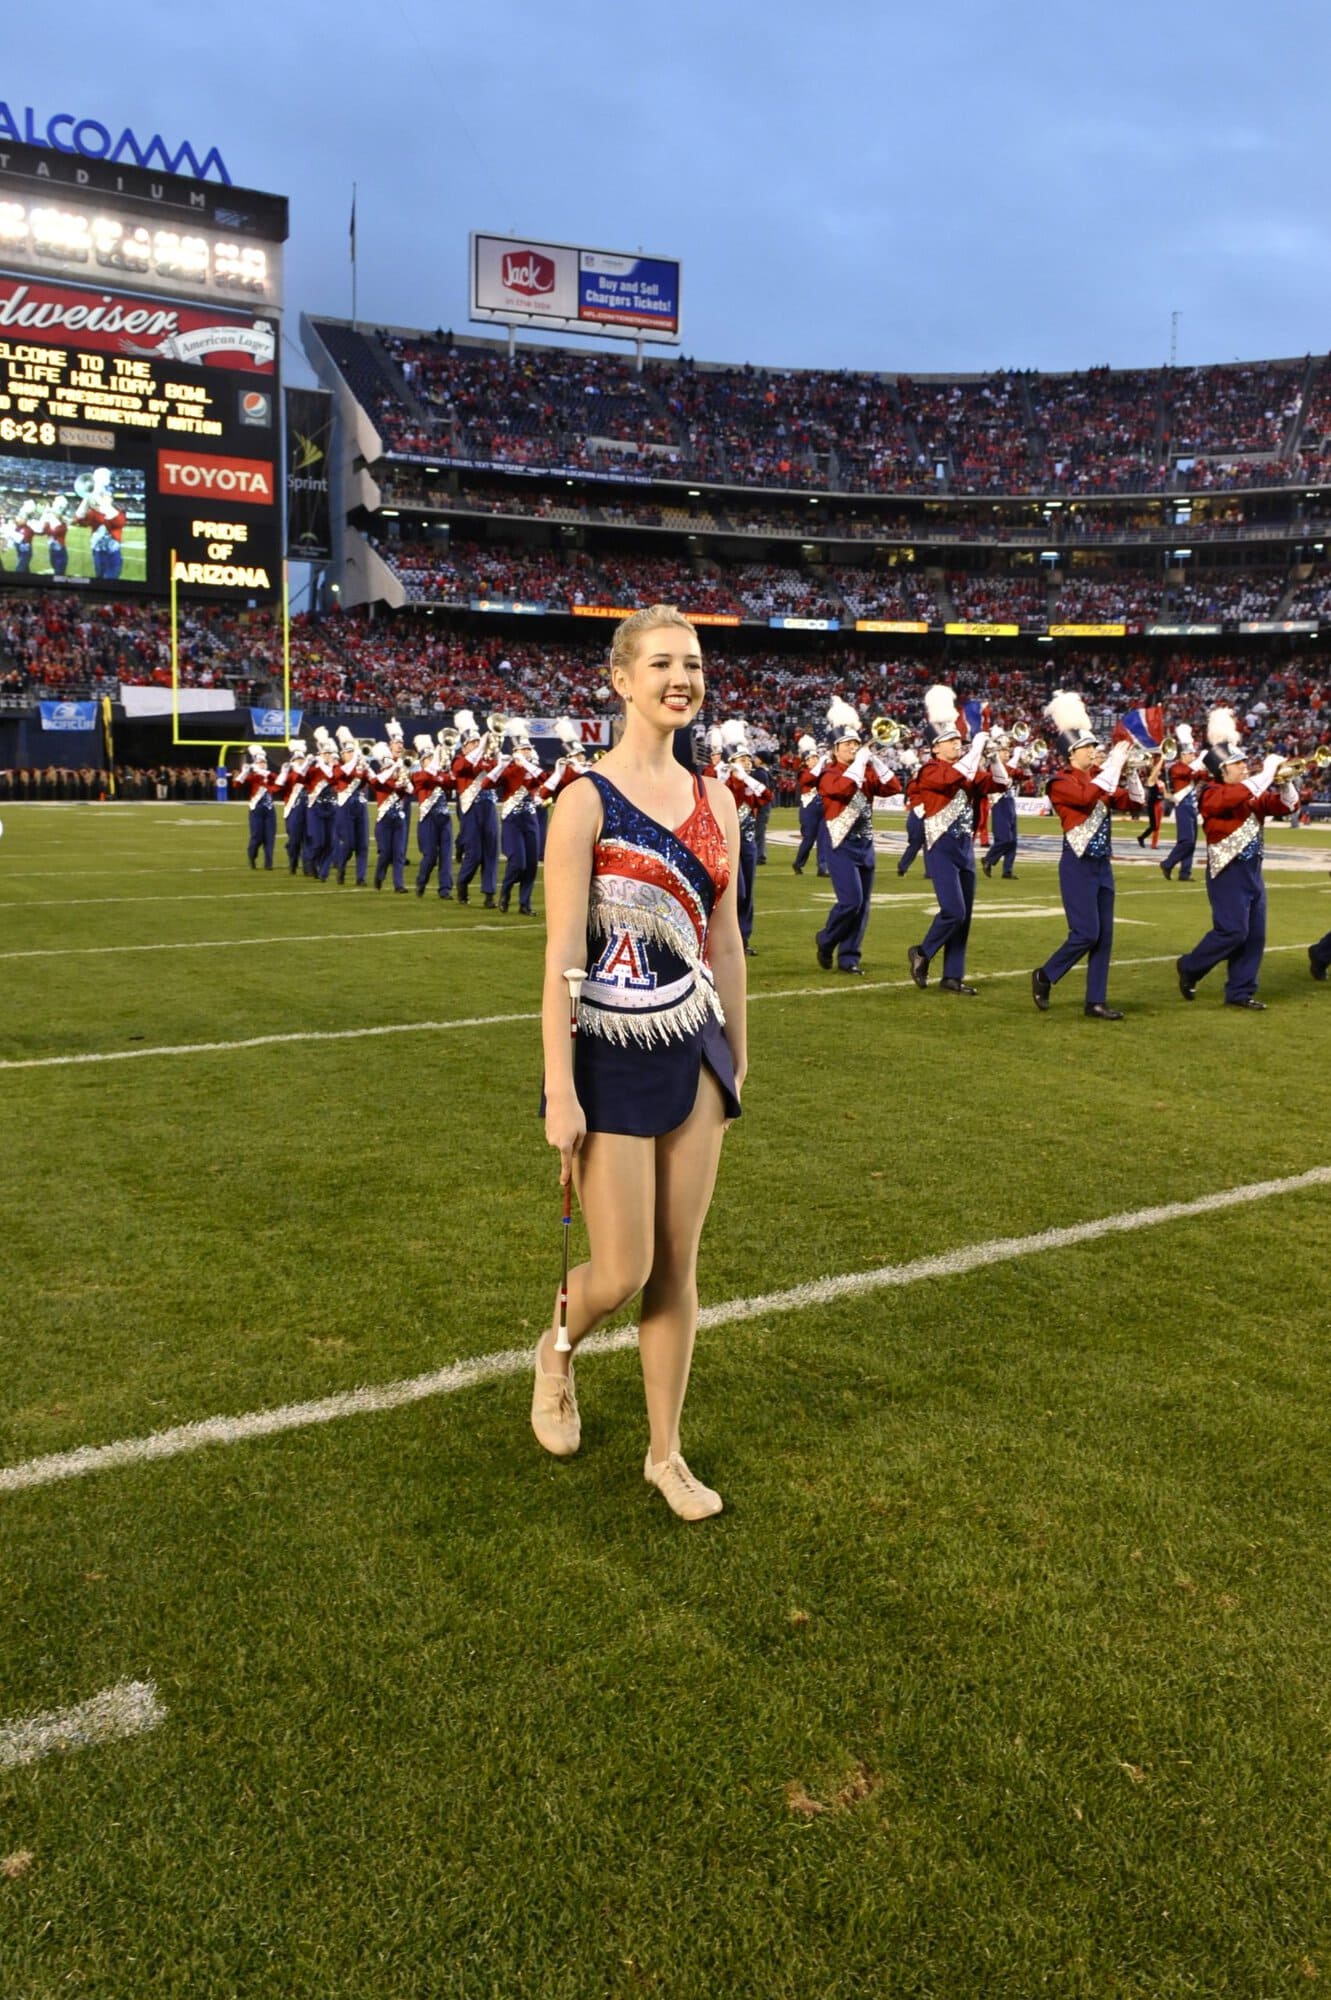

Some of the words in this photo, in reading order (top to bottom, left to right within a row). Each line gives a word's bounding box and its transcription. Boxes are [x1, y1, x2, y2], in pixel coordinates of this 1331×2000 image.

[504, 255, 554, 292] Jack
[599, 276, 618, 293] Buy
[620, 281, 638, 294] and
[640, 282, 659, 296] Sell
[586, 289, 631, 308] Chargers
[633, 295, 671, 313] Tickets!
[182, 335, 236, 355] American
[238, 335, 271, 353] Lager
[77, 353, 105, 371] TO
[113, 358, 151, 378] THE
[8, 362, 61, 383] LIFE
[70, 369, 156, 396] HOLIDAY
[18, 397, 40, 413] OF
[47, 400, 79, 418] THE
[55, 387, 143, 410] PRESENTED
[148, 398, 170, 413] BY
[175, 402, 205, 419] THE
[164, 463, 269, 495] TOYOTA
[288, 473, 328, 492] Sprint
[192, 520, 248, 542] PRIDE
[207, 543, 233, 560] OF
[174, 561, 271, 589] ARIZONA
[580, 721, 602, 743] N
[590, 927, 658, 990] A
